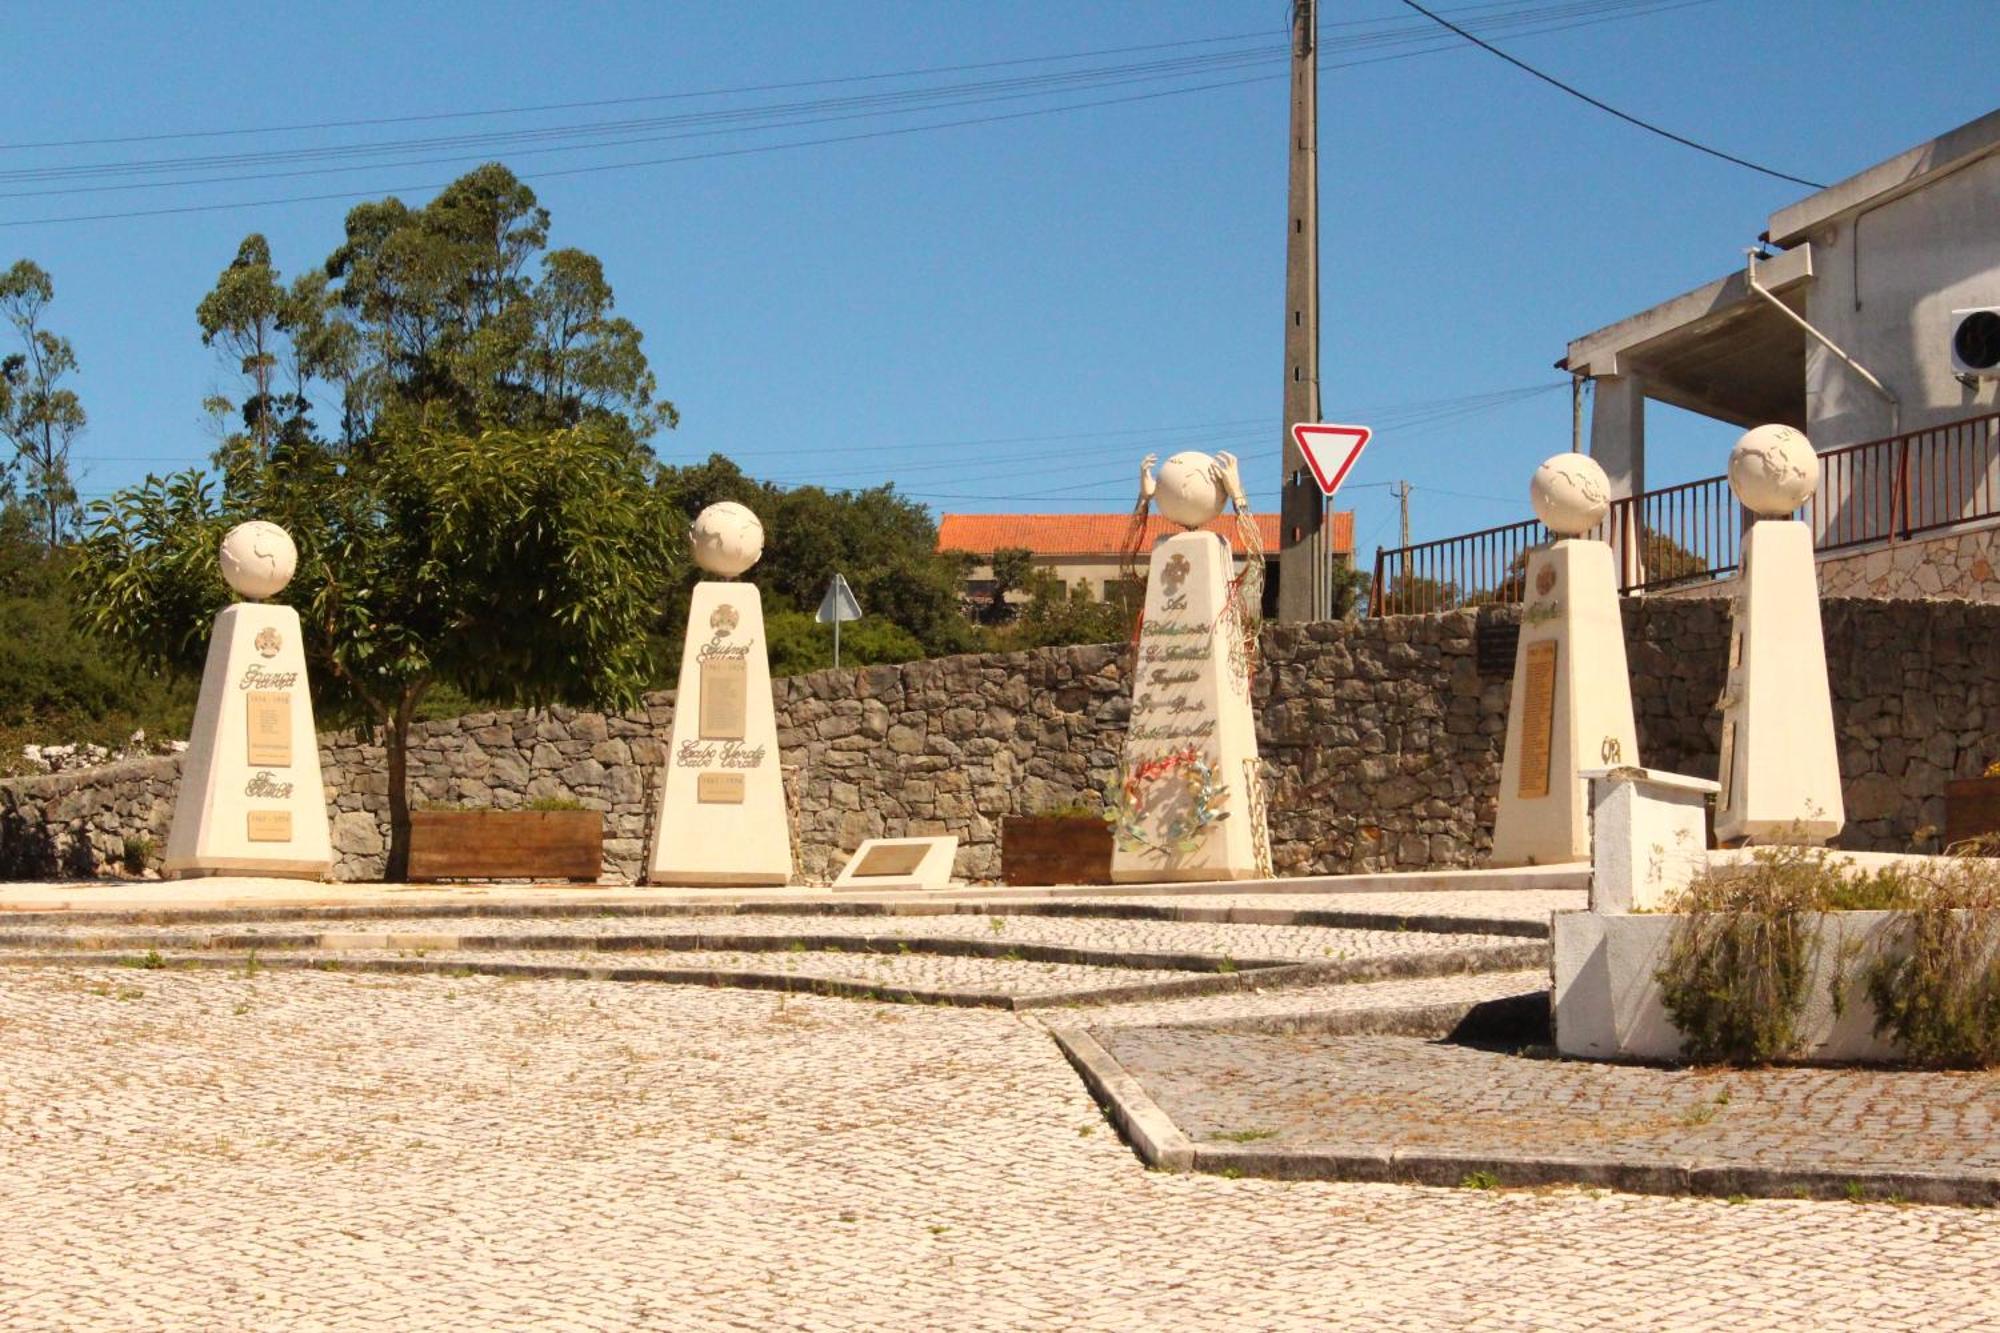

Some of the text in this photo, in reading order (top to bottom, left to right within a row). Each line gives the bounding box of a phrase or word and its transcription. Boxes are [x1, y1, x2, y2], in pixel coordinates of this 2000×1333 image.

[698, 637, 754, 658] Guiné
[240, 663, 299, 688] França
[677, 739, 766, 765] Cabo Verde
